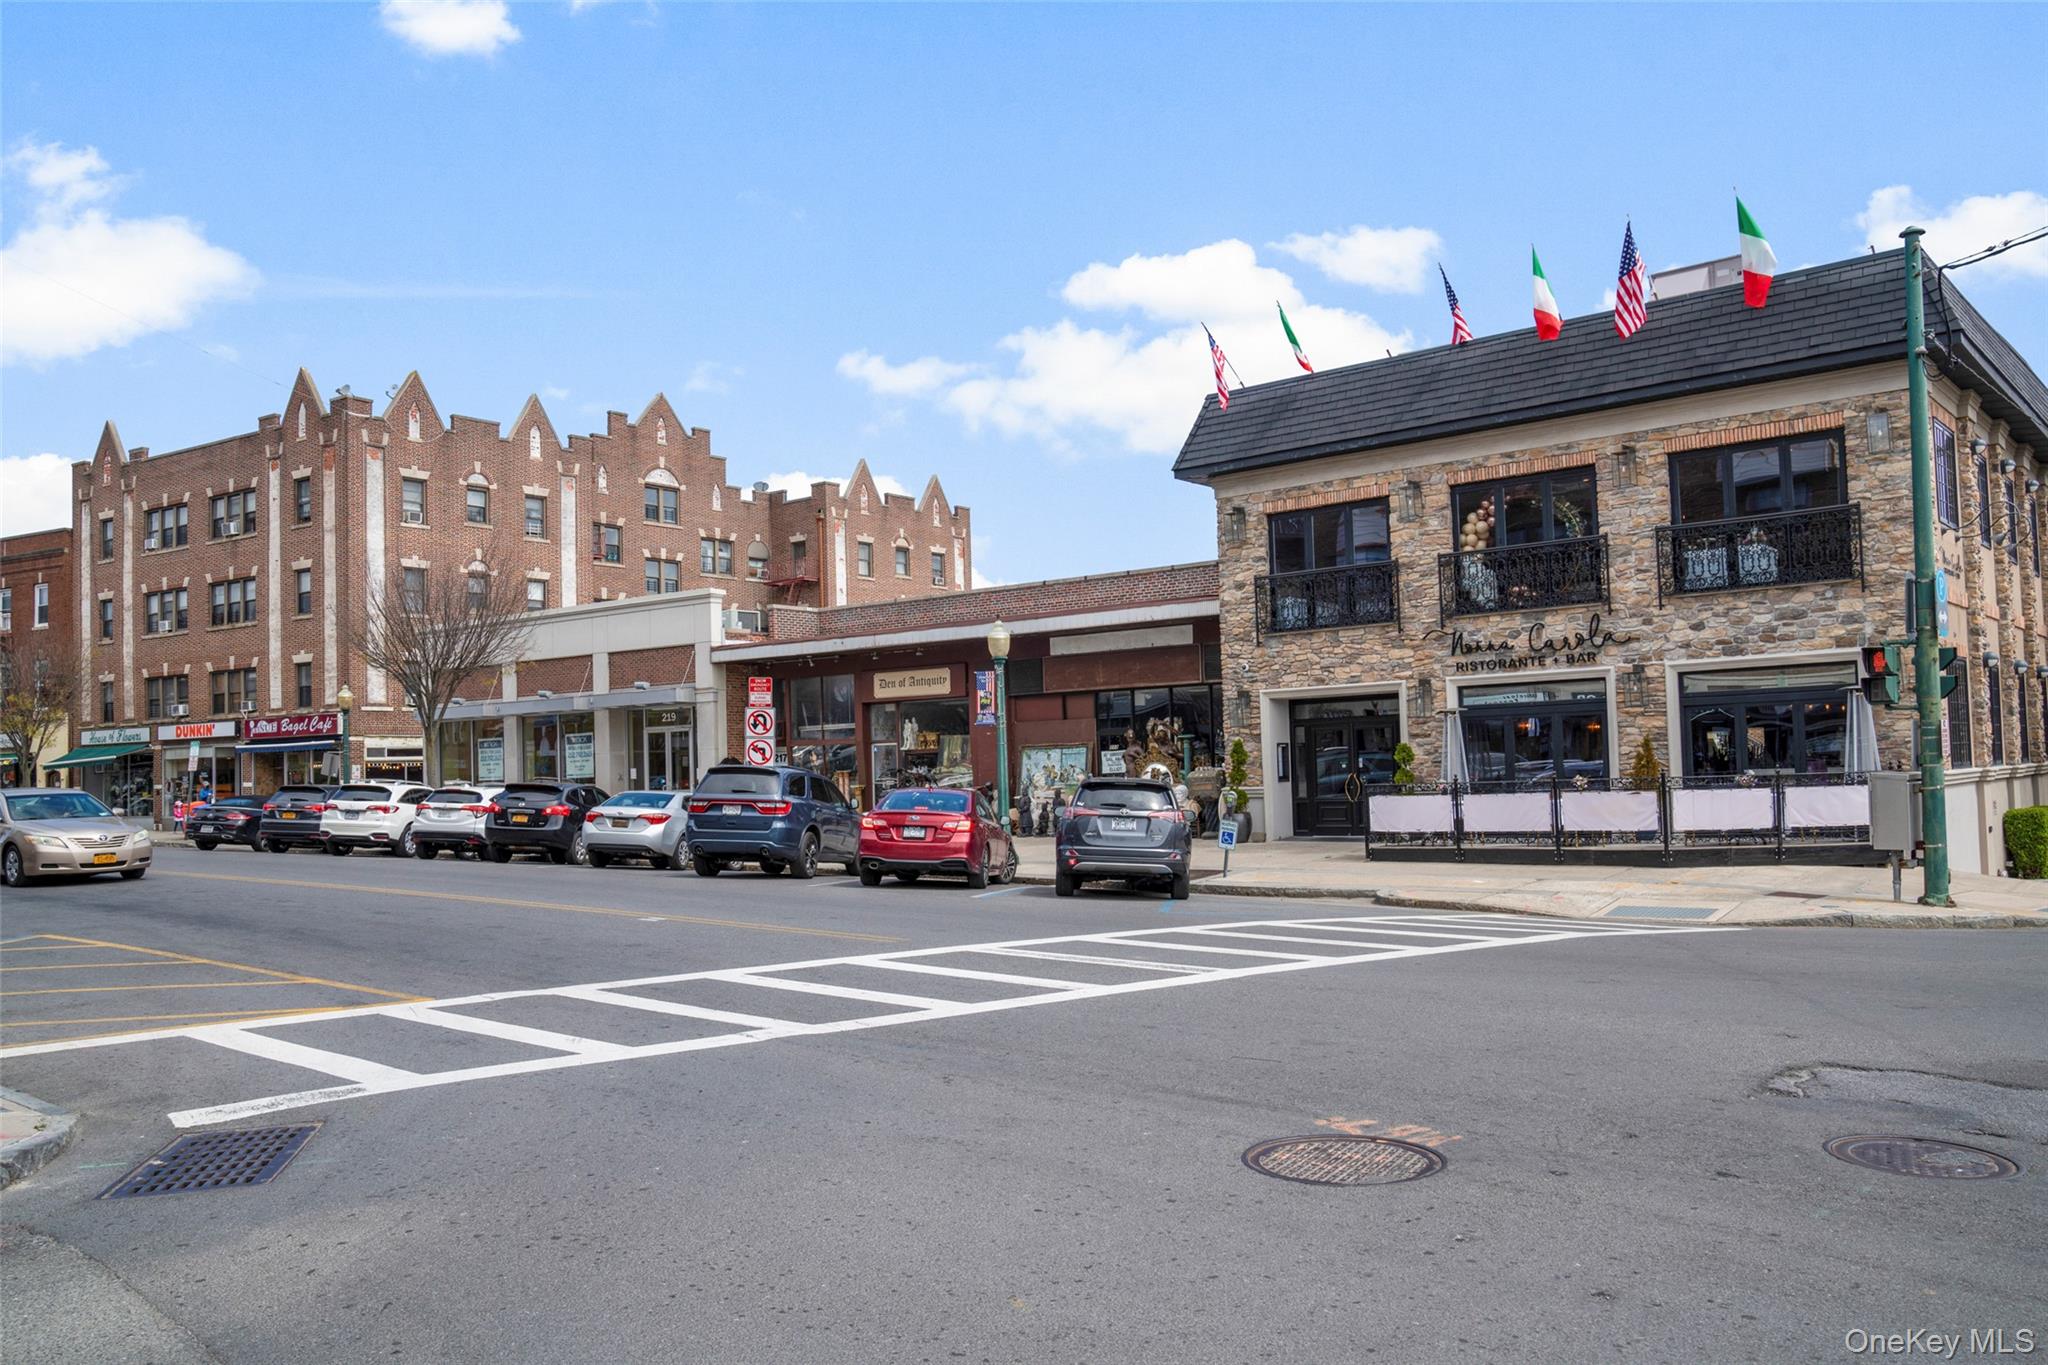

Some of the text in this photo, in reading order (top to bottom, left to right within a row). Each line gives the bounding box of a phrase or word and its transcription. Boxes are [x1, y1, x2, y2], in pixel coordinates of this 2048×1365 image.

[1423, 613, 1631, 656] Nonna Carola
[1456, 656, 1547, 673] RISTORANTE
[1566, 652, 1597, 664] BAR
[878, 676, 948, 689] Den of Antiquity
[661, 712, 677, 722] 219
[175, 723, 216, 738] DUNKIN'
[281, 717, 308, 735] Bagel
[775, 754, 787, 762] 217
